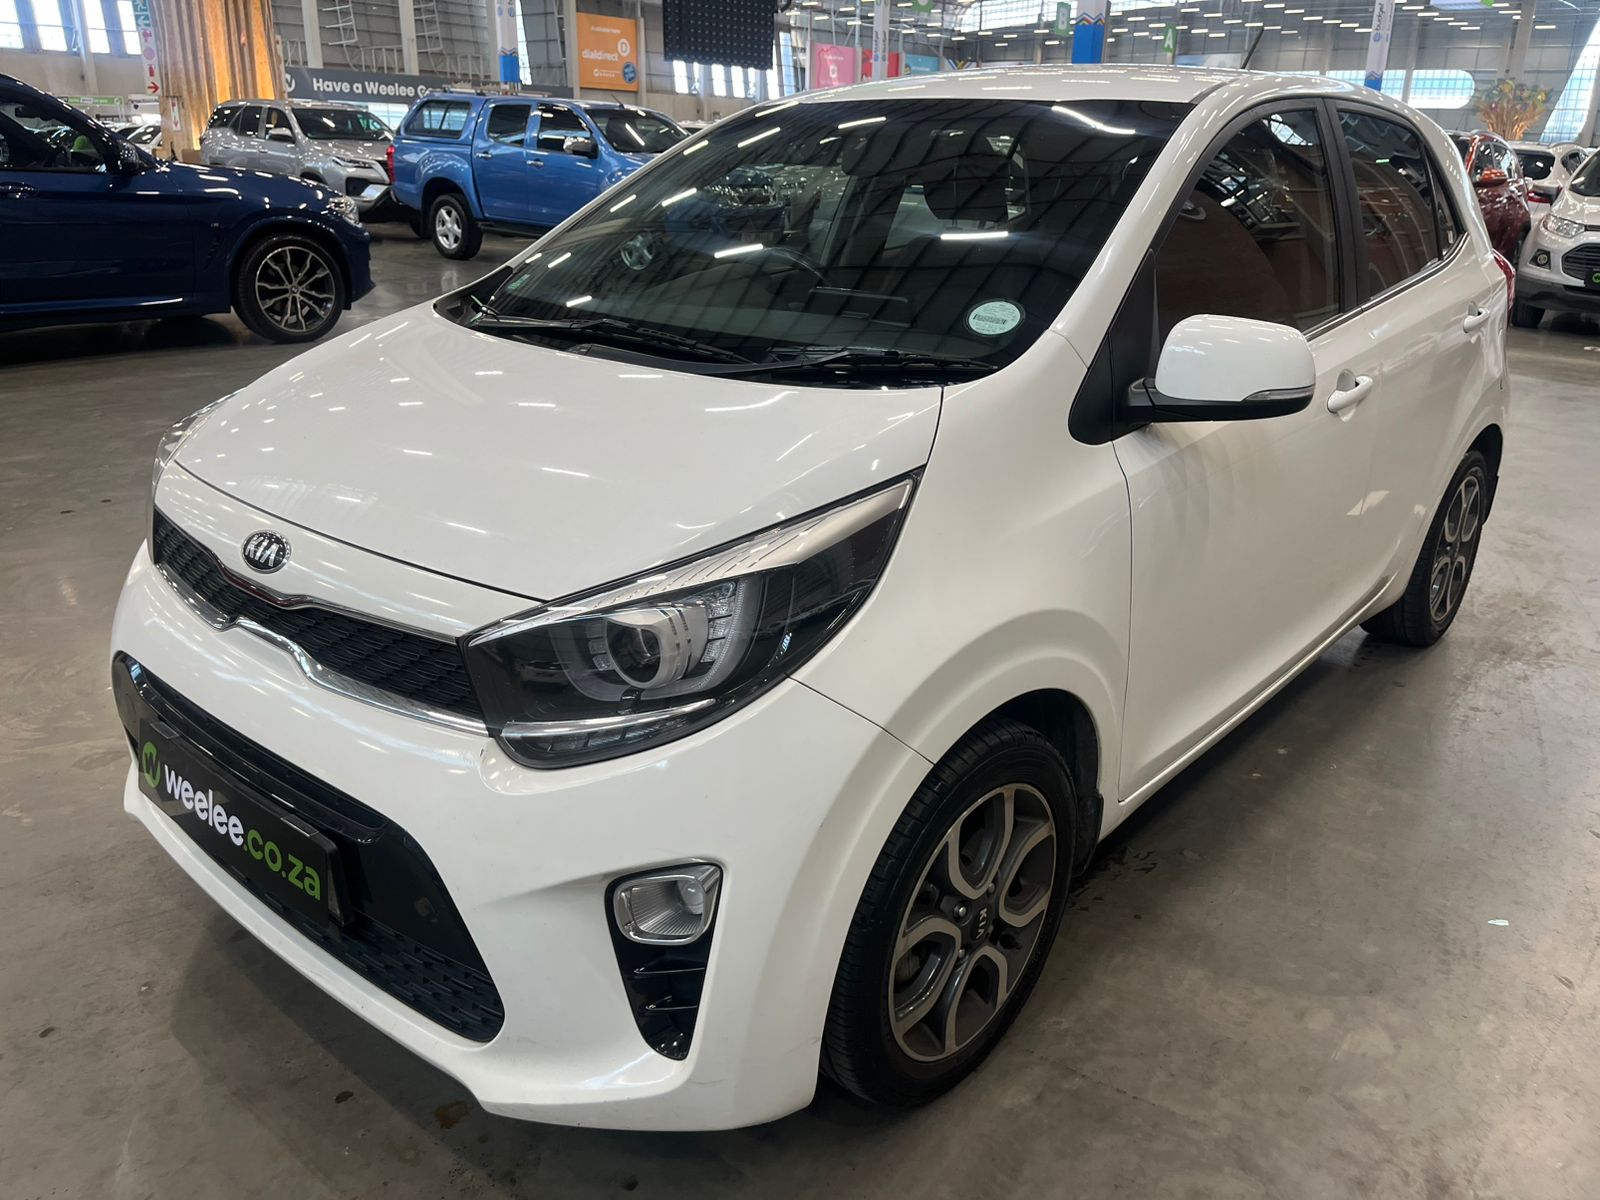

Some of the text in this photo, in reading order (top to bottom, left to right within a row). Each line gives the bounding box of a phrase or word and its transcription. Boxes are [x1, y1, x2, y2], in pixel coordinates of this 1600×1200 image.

[1165, 28, 1173, 48] A
[312, 78, 350, 92] Have
[353, 83, 362, 93] a
[365, 81, 415, 97] Weelee
[245, 535, 279, 567] KIA
[164, 764, 321, 901] weelee.co.za
[976, 907, 987, 940] KIA
